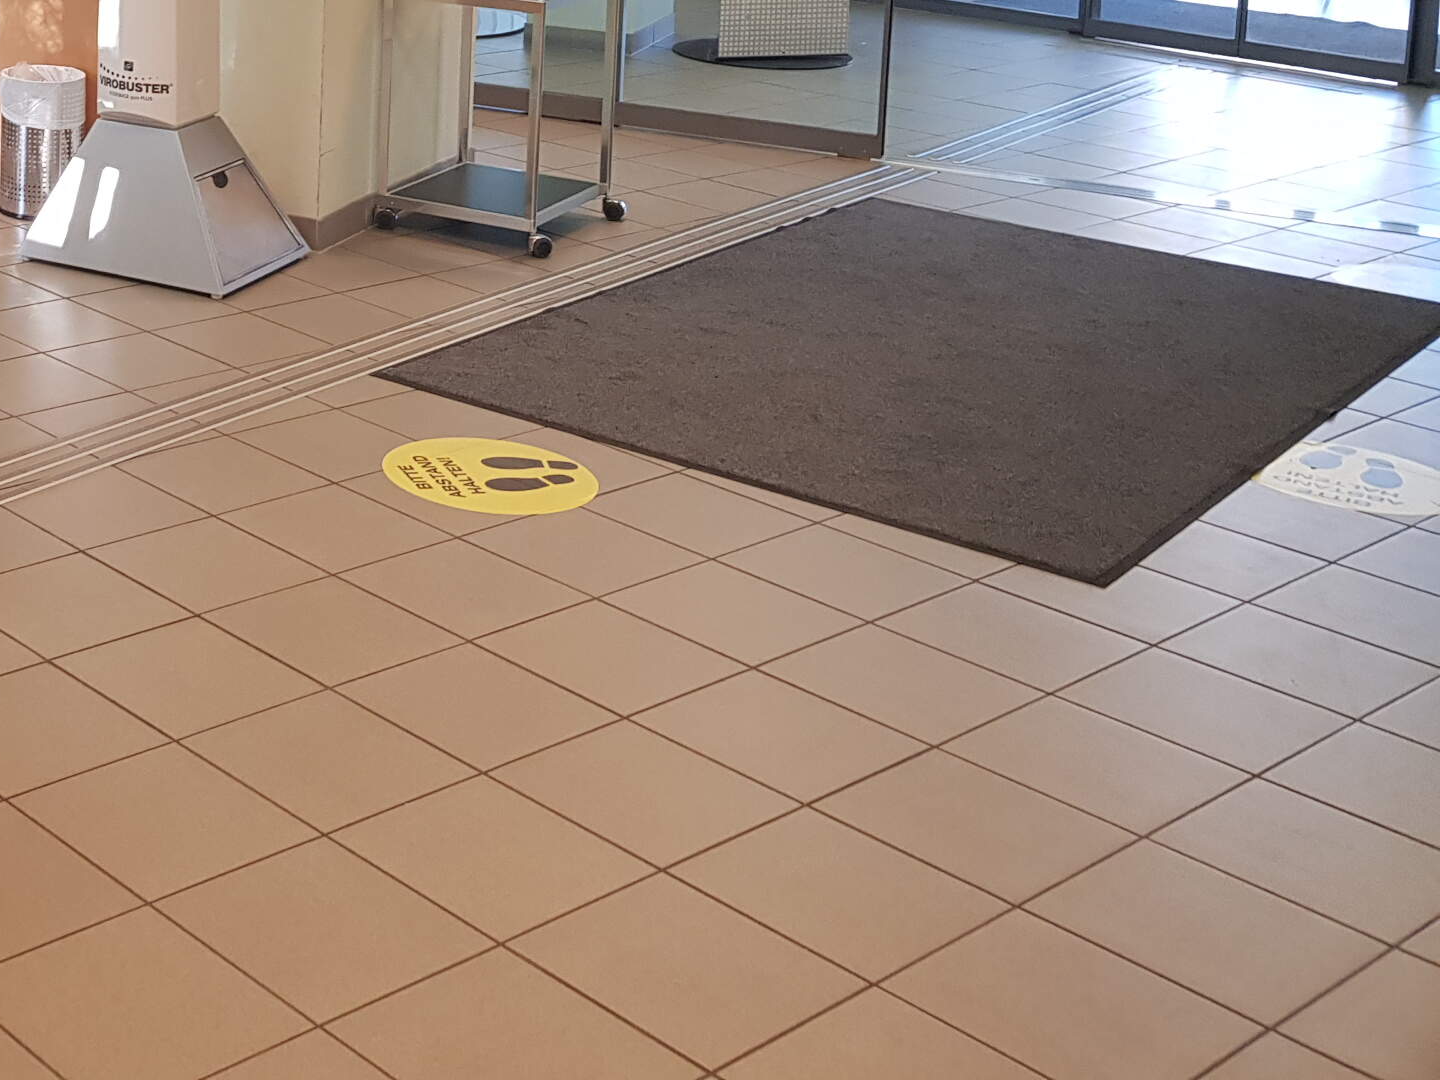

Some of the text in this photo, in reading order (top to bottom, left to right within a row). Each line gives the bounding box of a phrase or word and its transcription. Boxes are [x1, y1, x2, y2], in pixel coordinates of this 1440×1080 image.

[397, 464, 433, 490] BITTE
[412, 455, 467, 498] ABSTAND
[436, 456, 486, 495] HALTEN!
